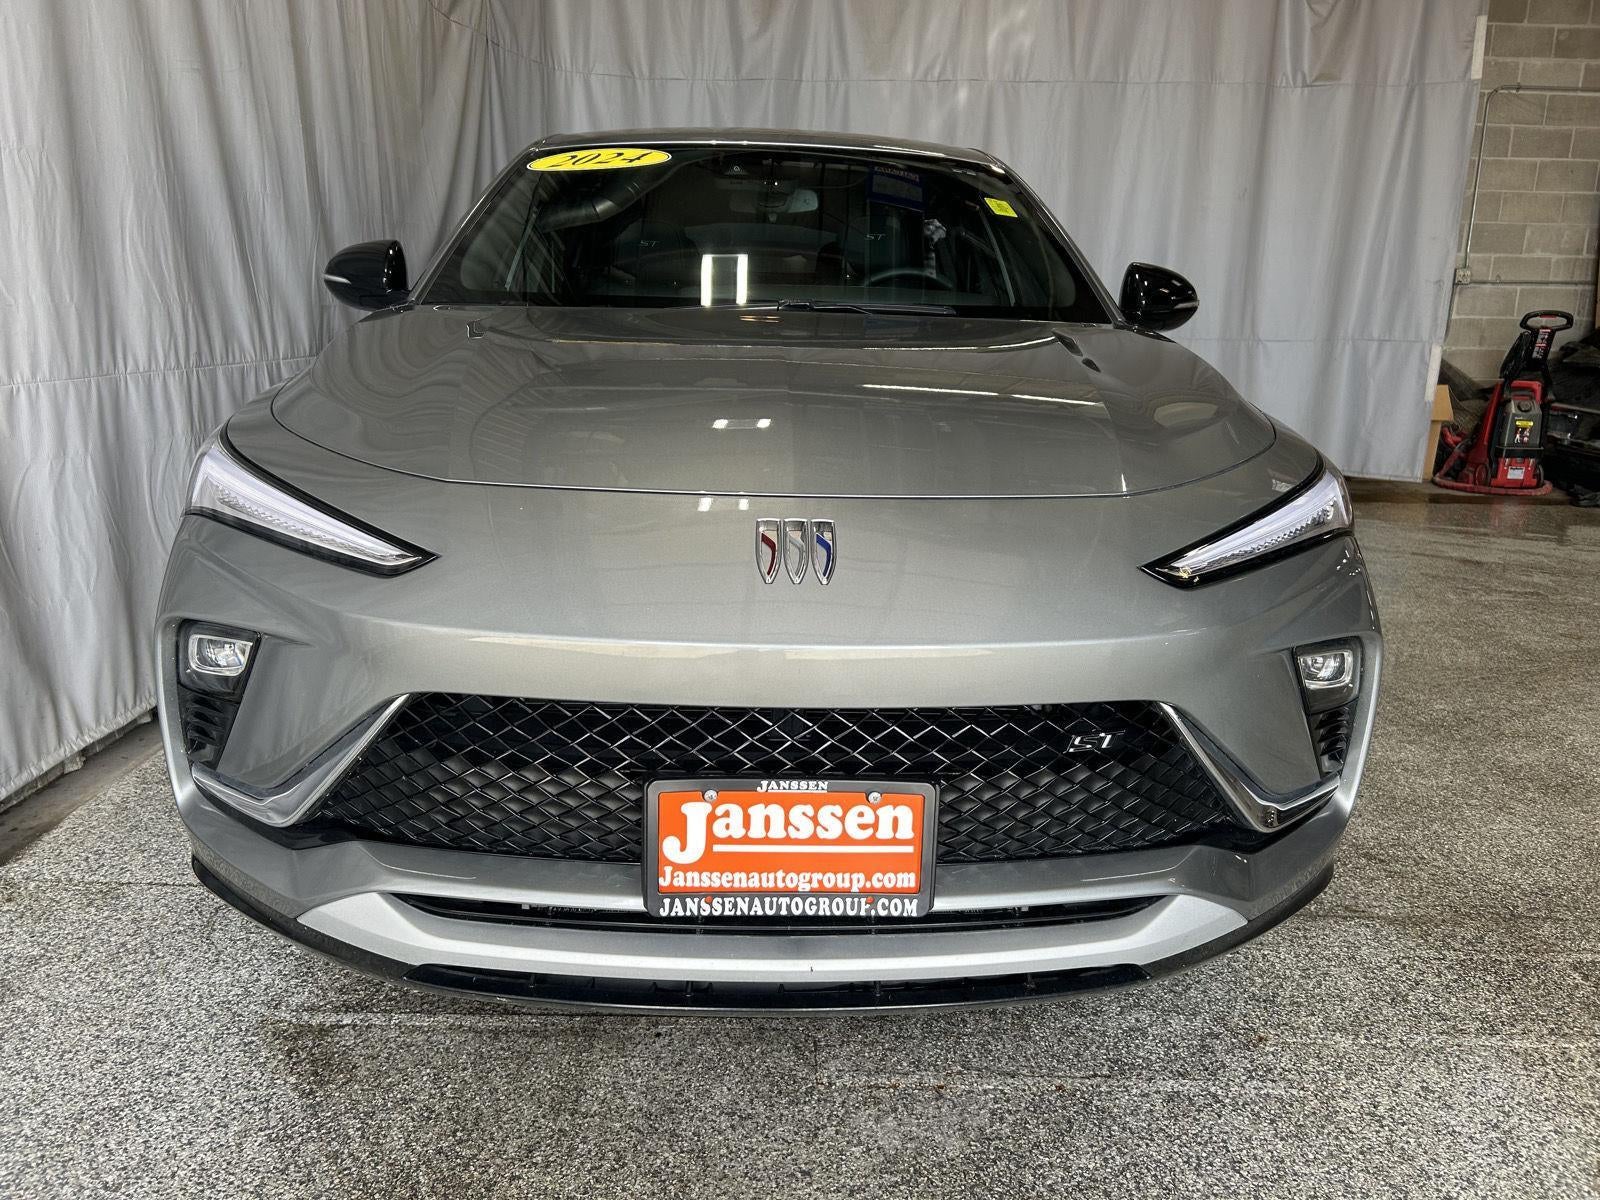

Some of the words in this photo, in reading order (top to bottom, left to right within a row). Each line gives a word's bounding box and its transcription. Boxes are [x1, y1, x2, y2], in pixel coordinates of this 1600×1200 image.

[545, 151, 653, 168] 2024
[756, 780, 828, 793] JANSSEN
[662, 801, 915, 865] Janssen
[659, 865, 916, 892] Janssenautogroup.com
